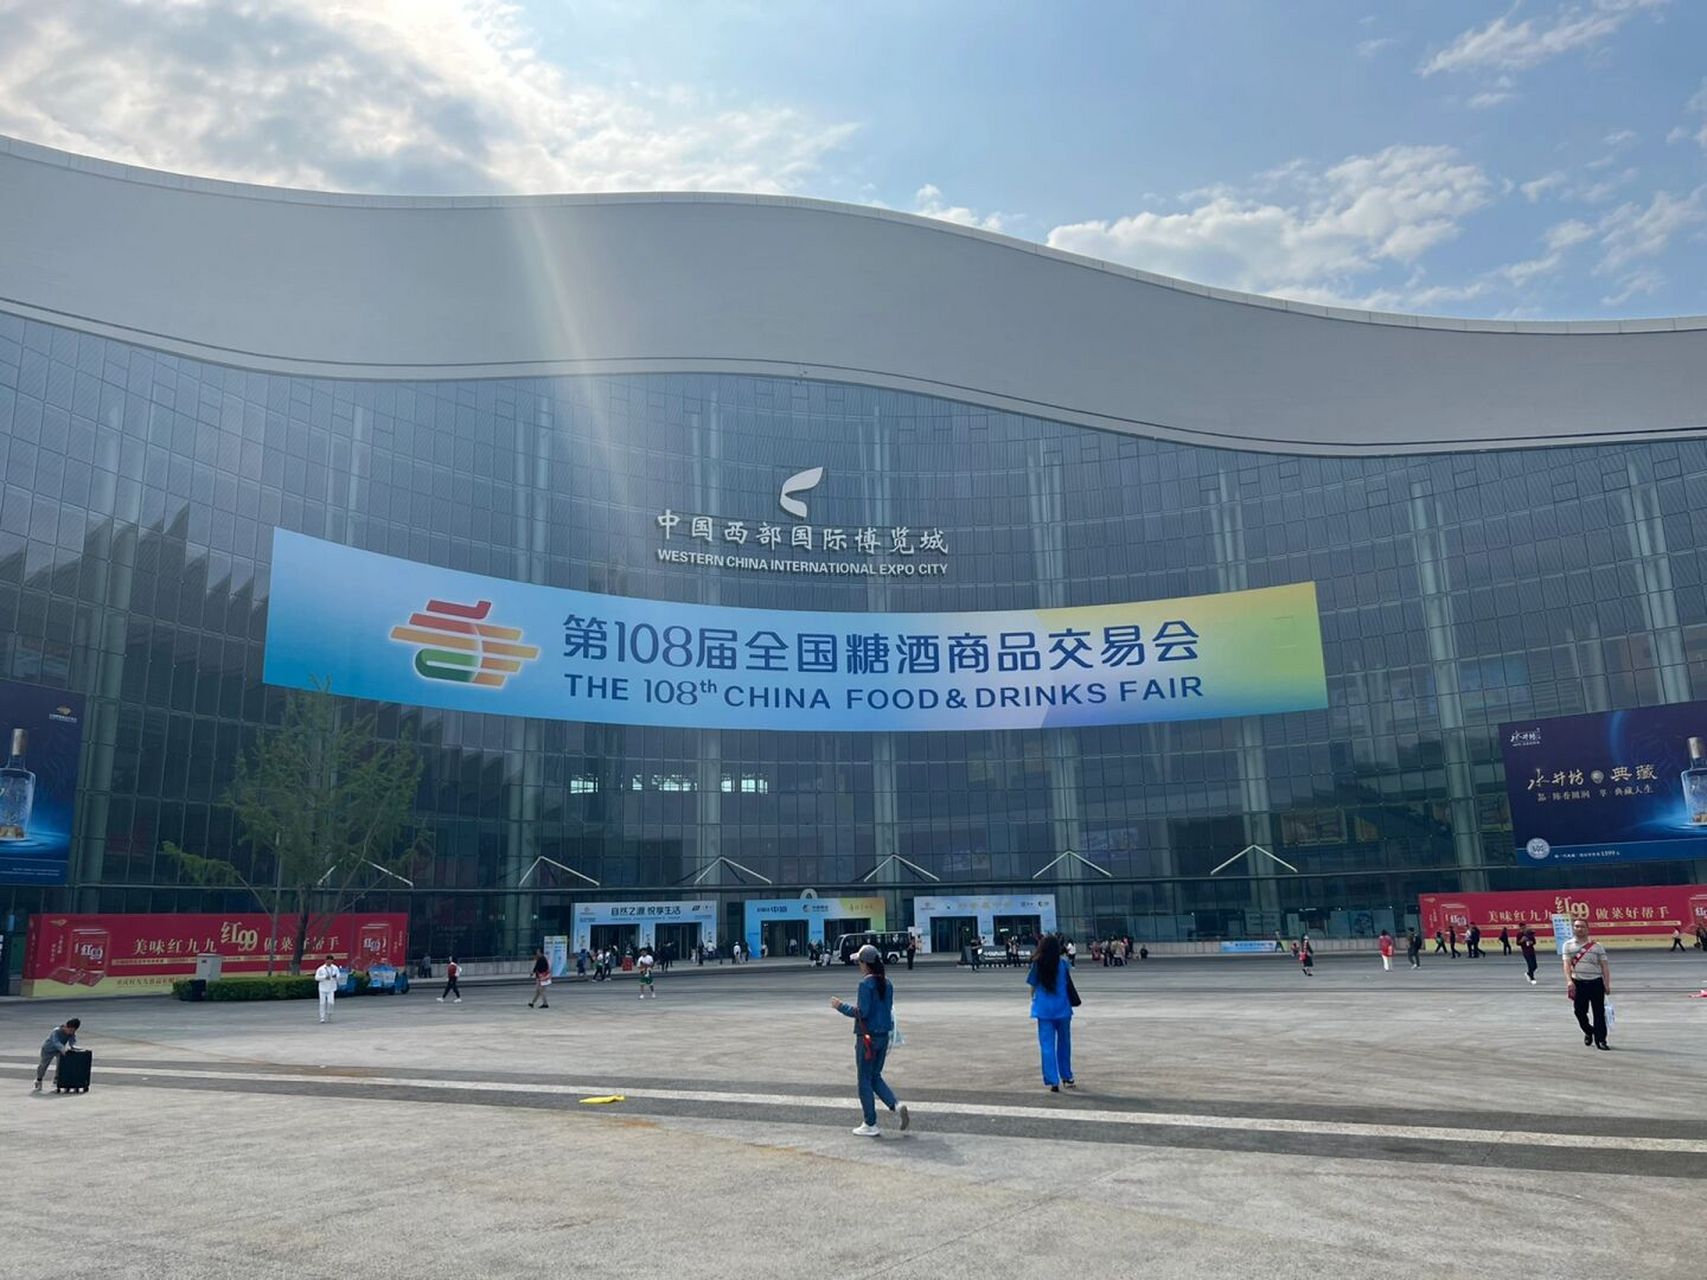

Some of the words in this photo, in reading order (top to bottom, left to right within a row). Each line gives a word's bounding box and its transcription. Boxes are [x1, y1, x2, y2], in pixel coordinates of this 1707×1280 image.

[657, 509, 949, 555] 中国西部国际博览城
[657, 549, 724, 567] WESTERN
[726, 556, 768, 570] CHINA
[770, 559, 877, 575] INTERNATIONAL
[879, 564, 914, 576] EXPO
[918, 563, 949, 576] CITY
[562, 614, 1199, 675] 第108届全国糖酒商品交易会
[563, 673, 629, 701] THE
[644, 678, 718, 706] 108th
[724, 685, 831, 710] CHINA
[1119, 676, 1204, 702] FAIR
[1527, 768, 1585, 790] 水井坊
[1610, 764, 1658, 782] 典藏
[134, 938, 217, 955] 美味红九九
